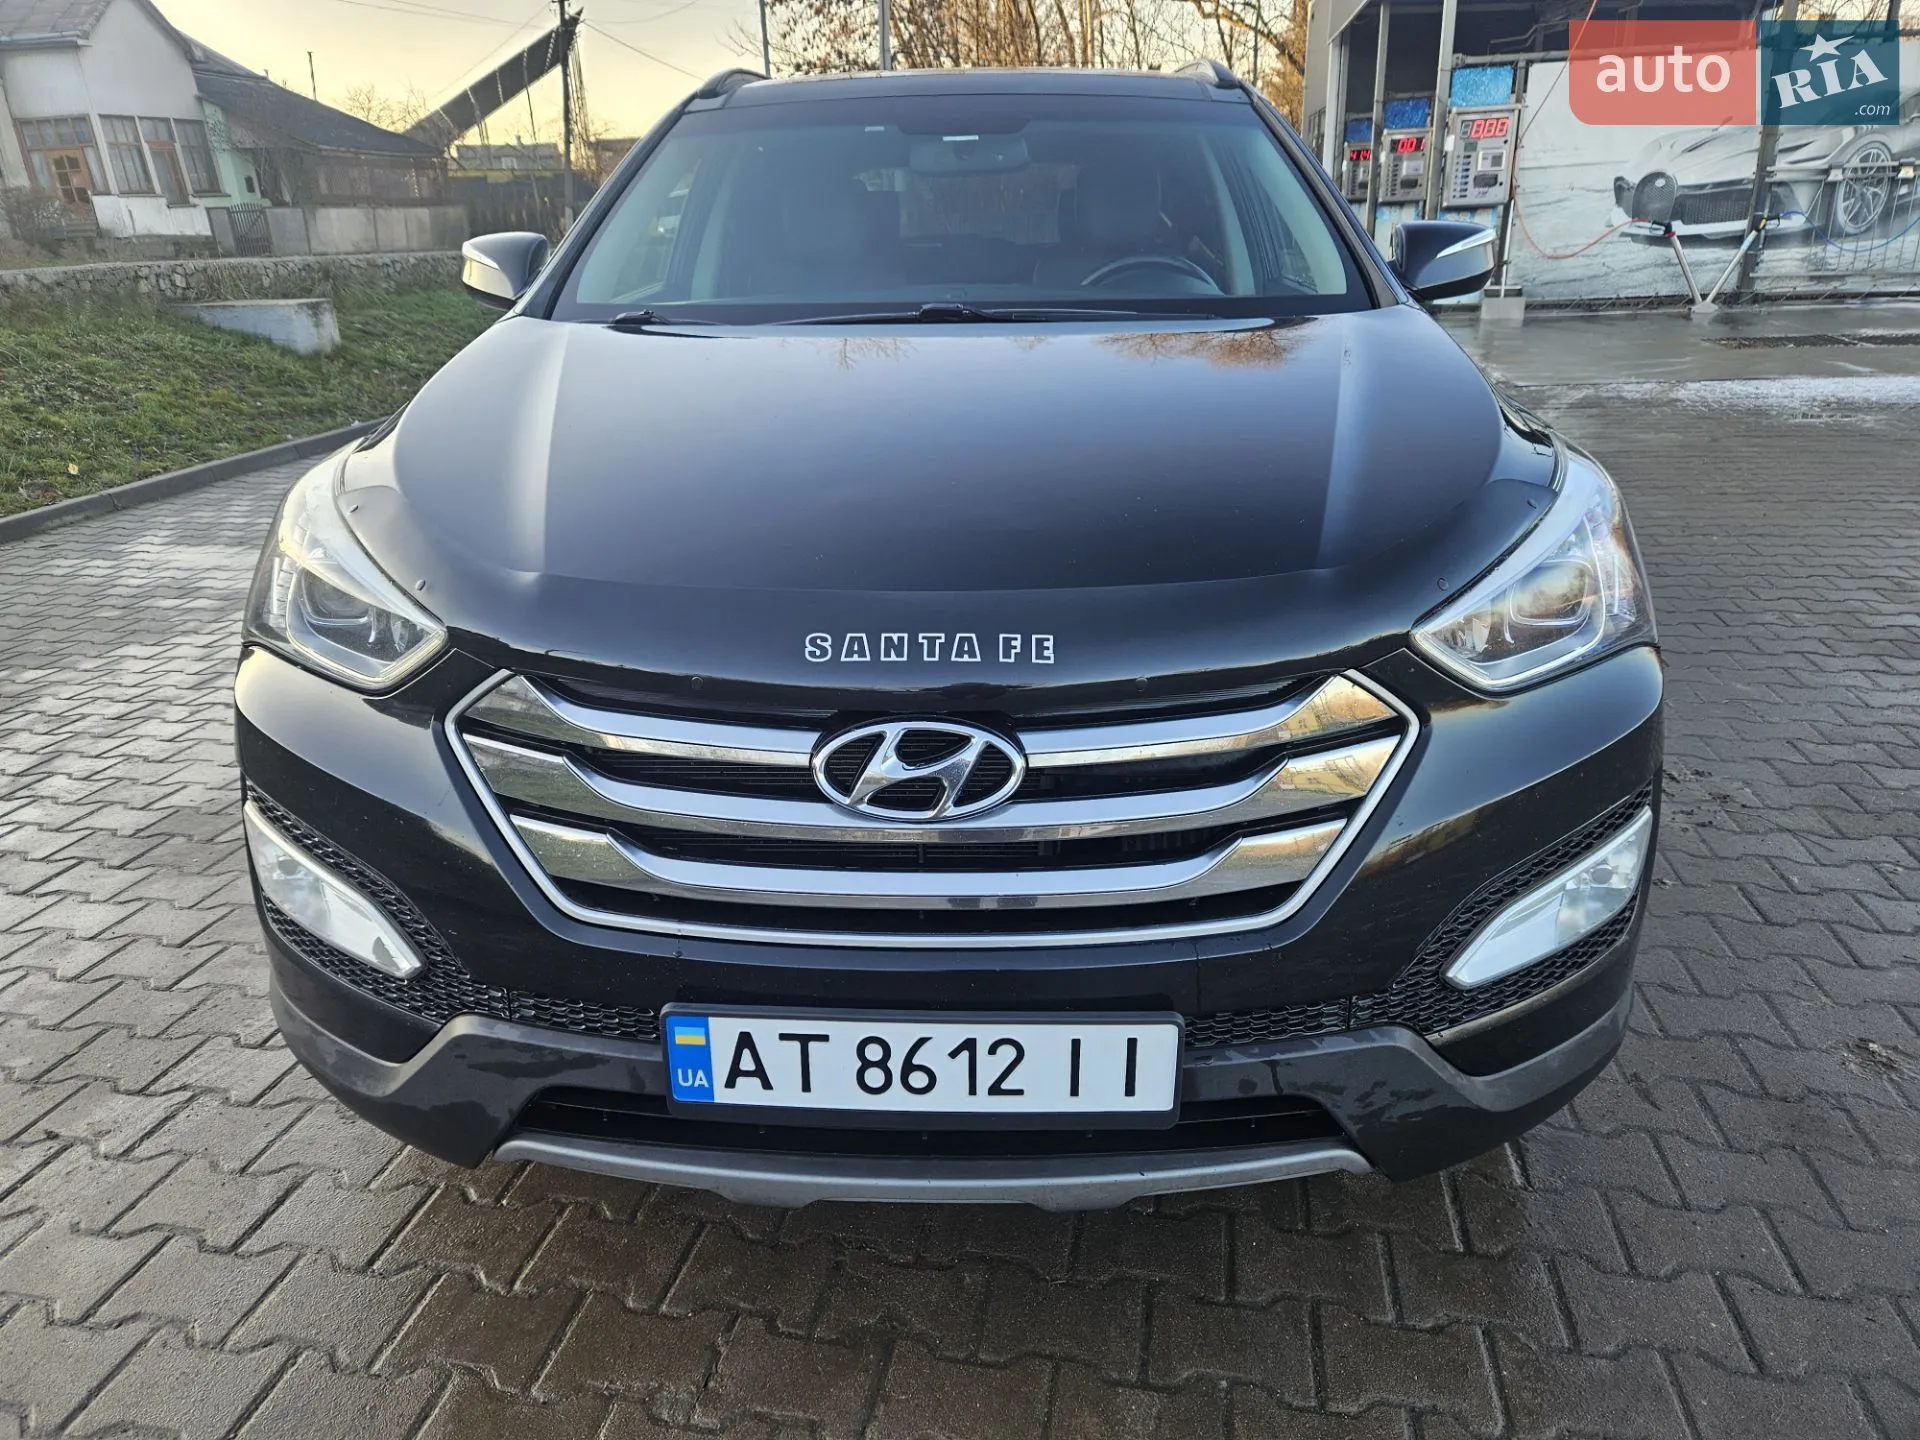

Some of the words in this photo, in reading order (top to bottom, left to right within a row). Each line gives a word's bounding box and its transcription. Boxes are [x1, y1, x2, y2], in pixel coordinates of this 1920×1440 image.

[804, 632, 982, 662] SANTA
[998, 633, 1055, 664] FE
[677, 1067, 709, 1088] UA
[724, 1031, 830, 1093] AT
[855, 1035, 1026, 1097] 8612
